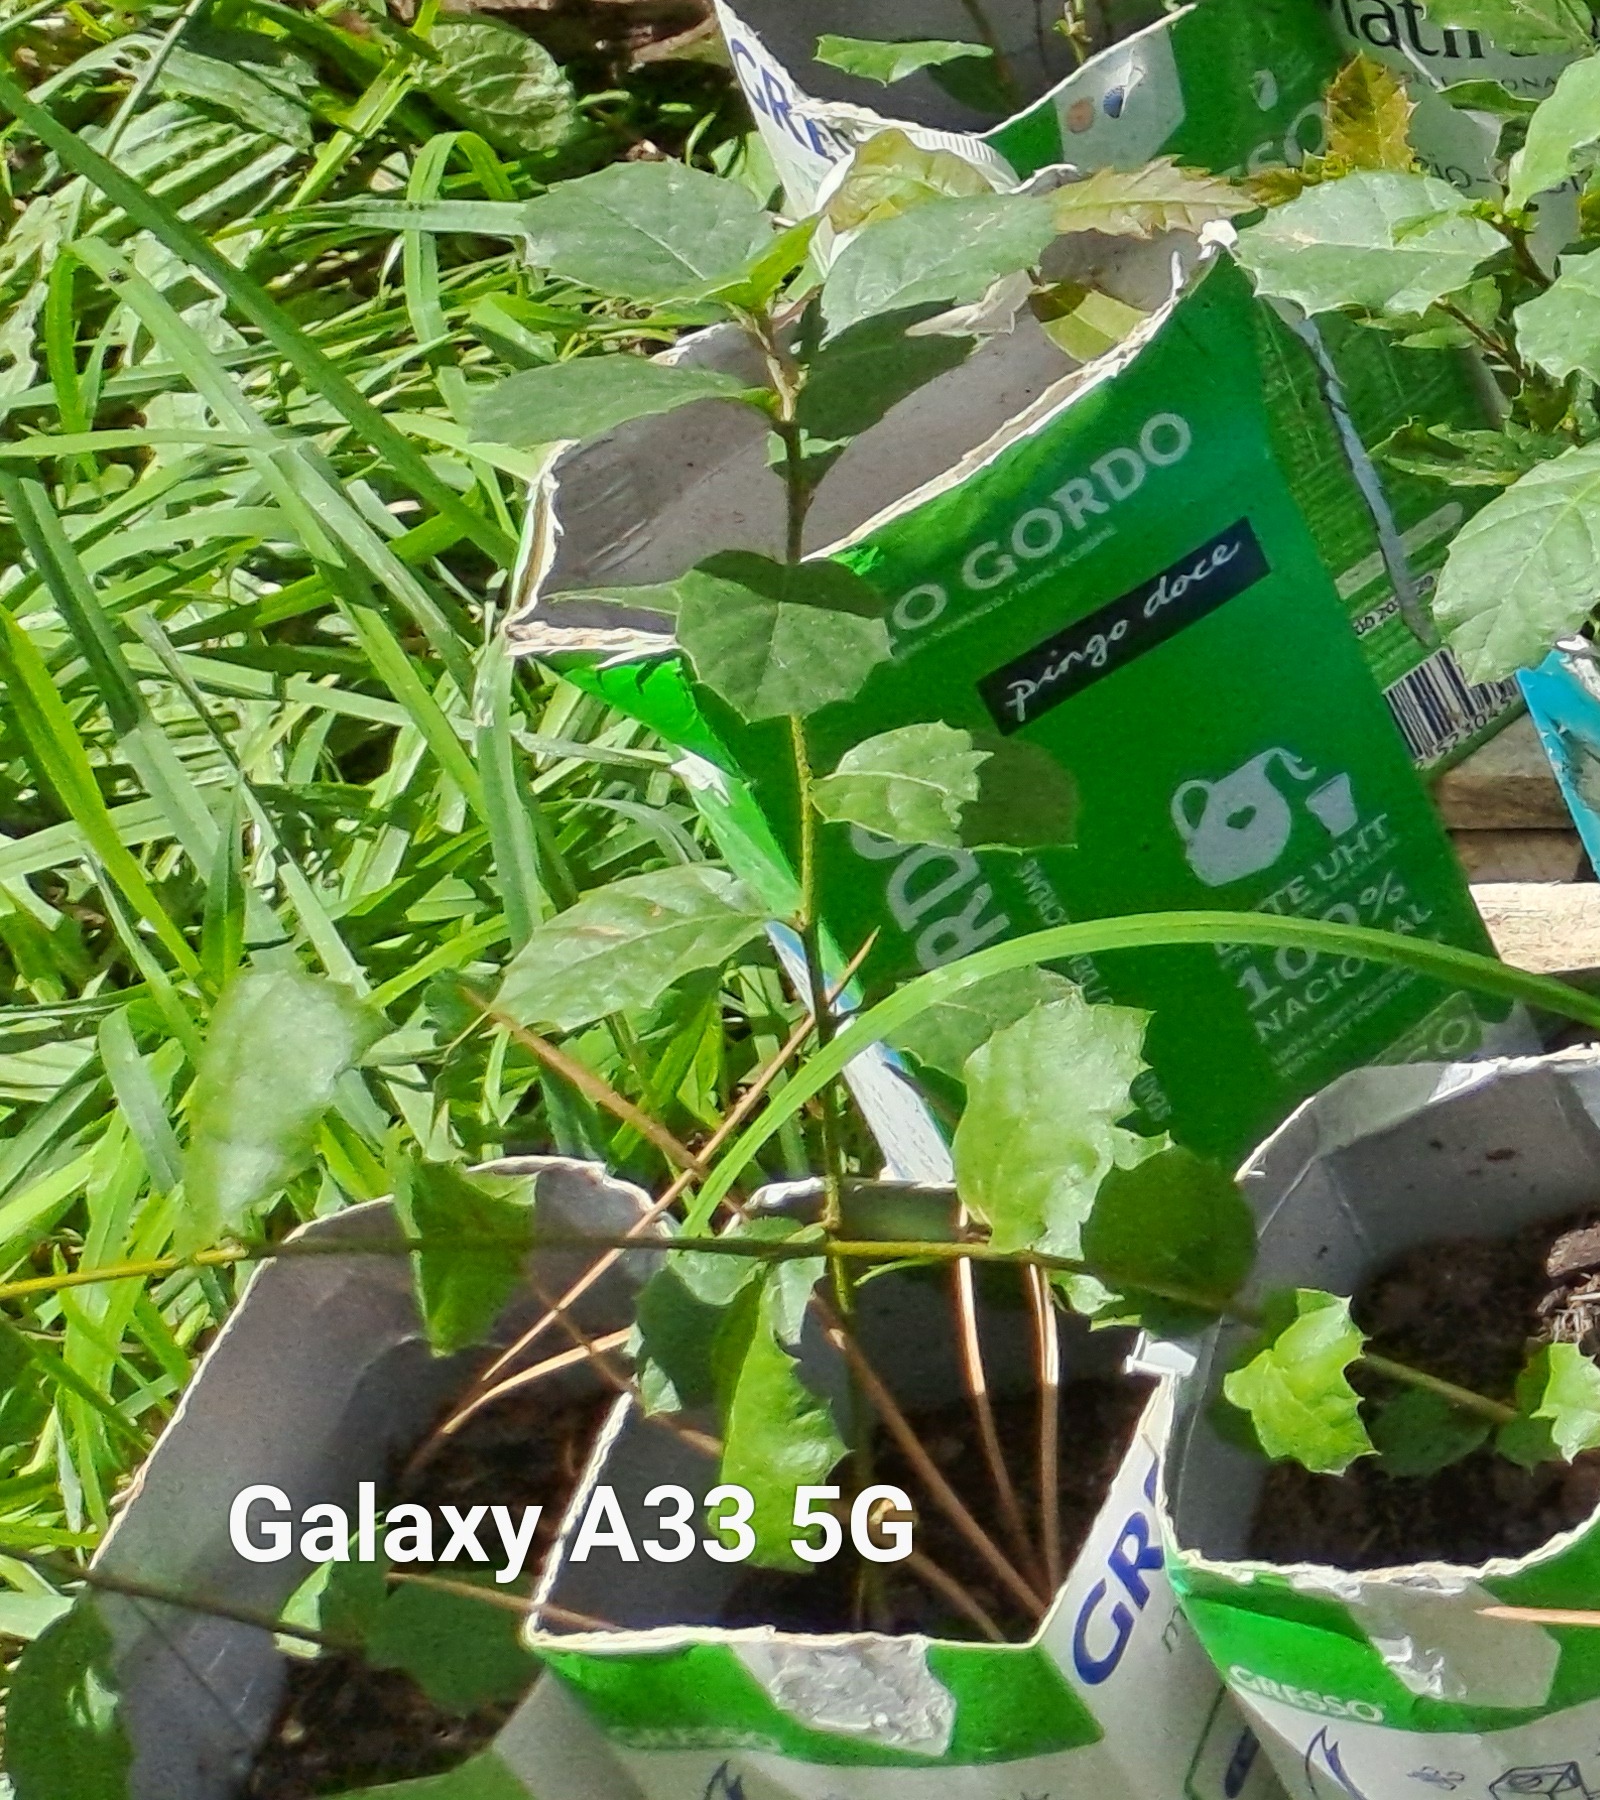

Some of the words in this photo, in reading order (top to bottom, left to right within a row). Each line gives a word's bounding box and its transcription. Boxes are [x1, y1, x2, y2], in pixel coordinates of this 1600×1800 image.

[960, 411, 1195, 595] GORDO
[1002, 616, 1130, 725] pingo
[1141, 536, 1242, 620] doce
[1311, 812, 1388, 881] UHT
[1255, 903, 1433, 1044] NACIOAL
[1227, 1664, 1388, 1725] GRESSO
